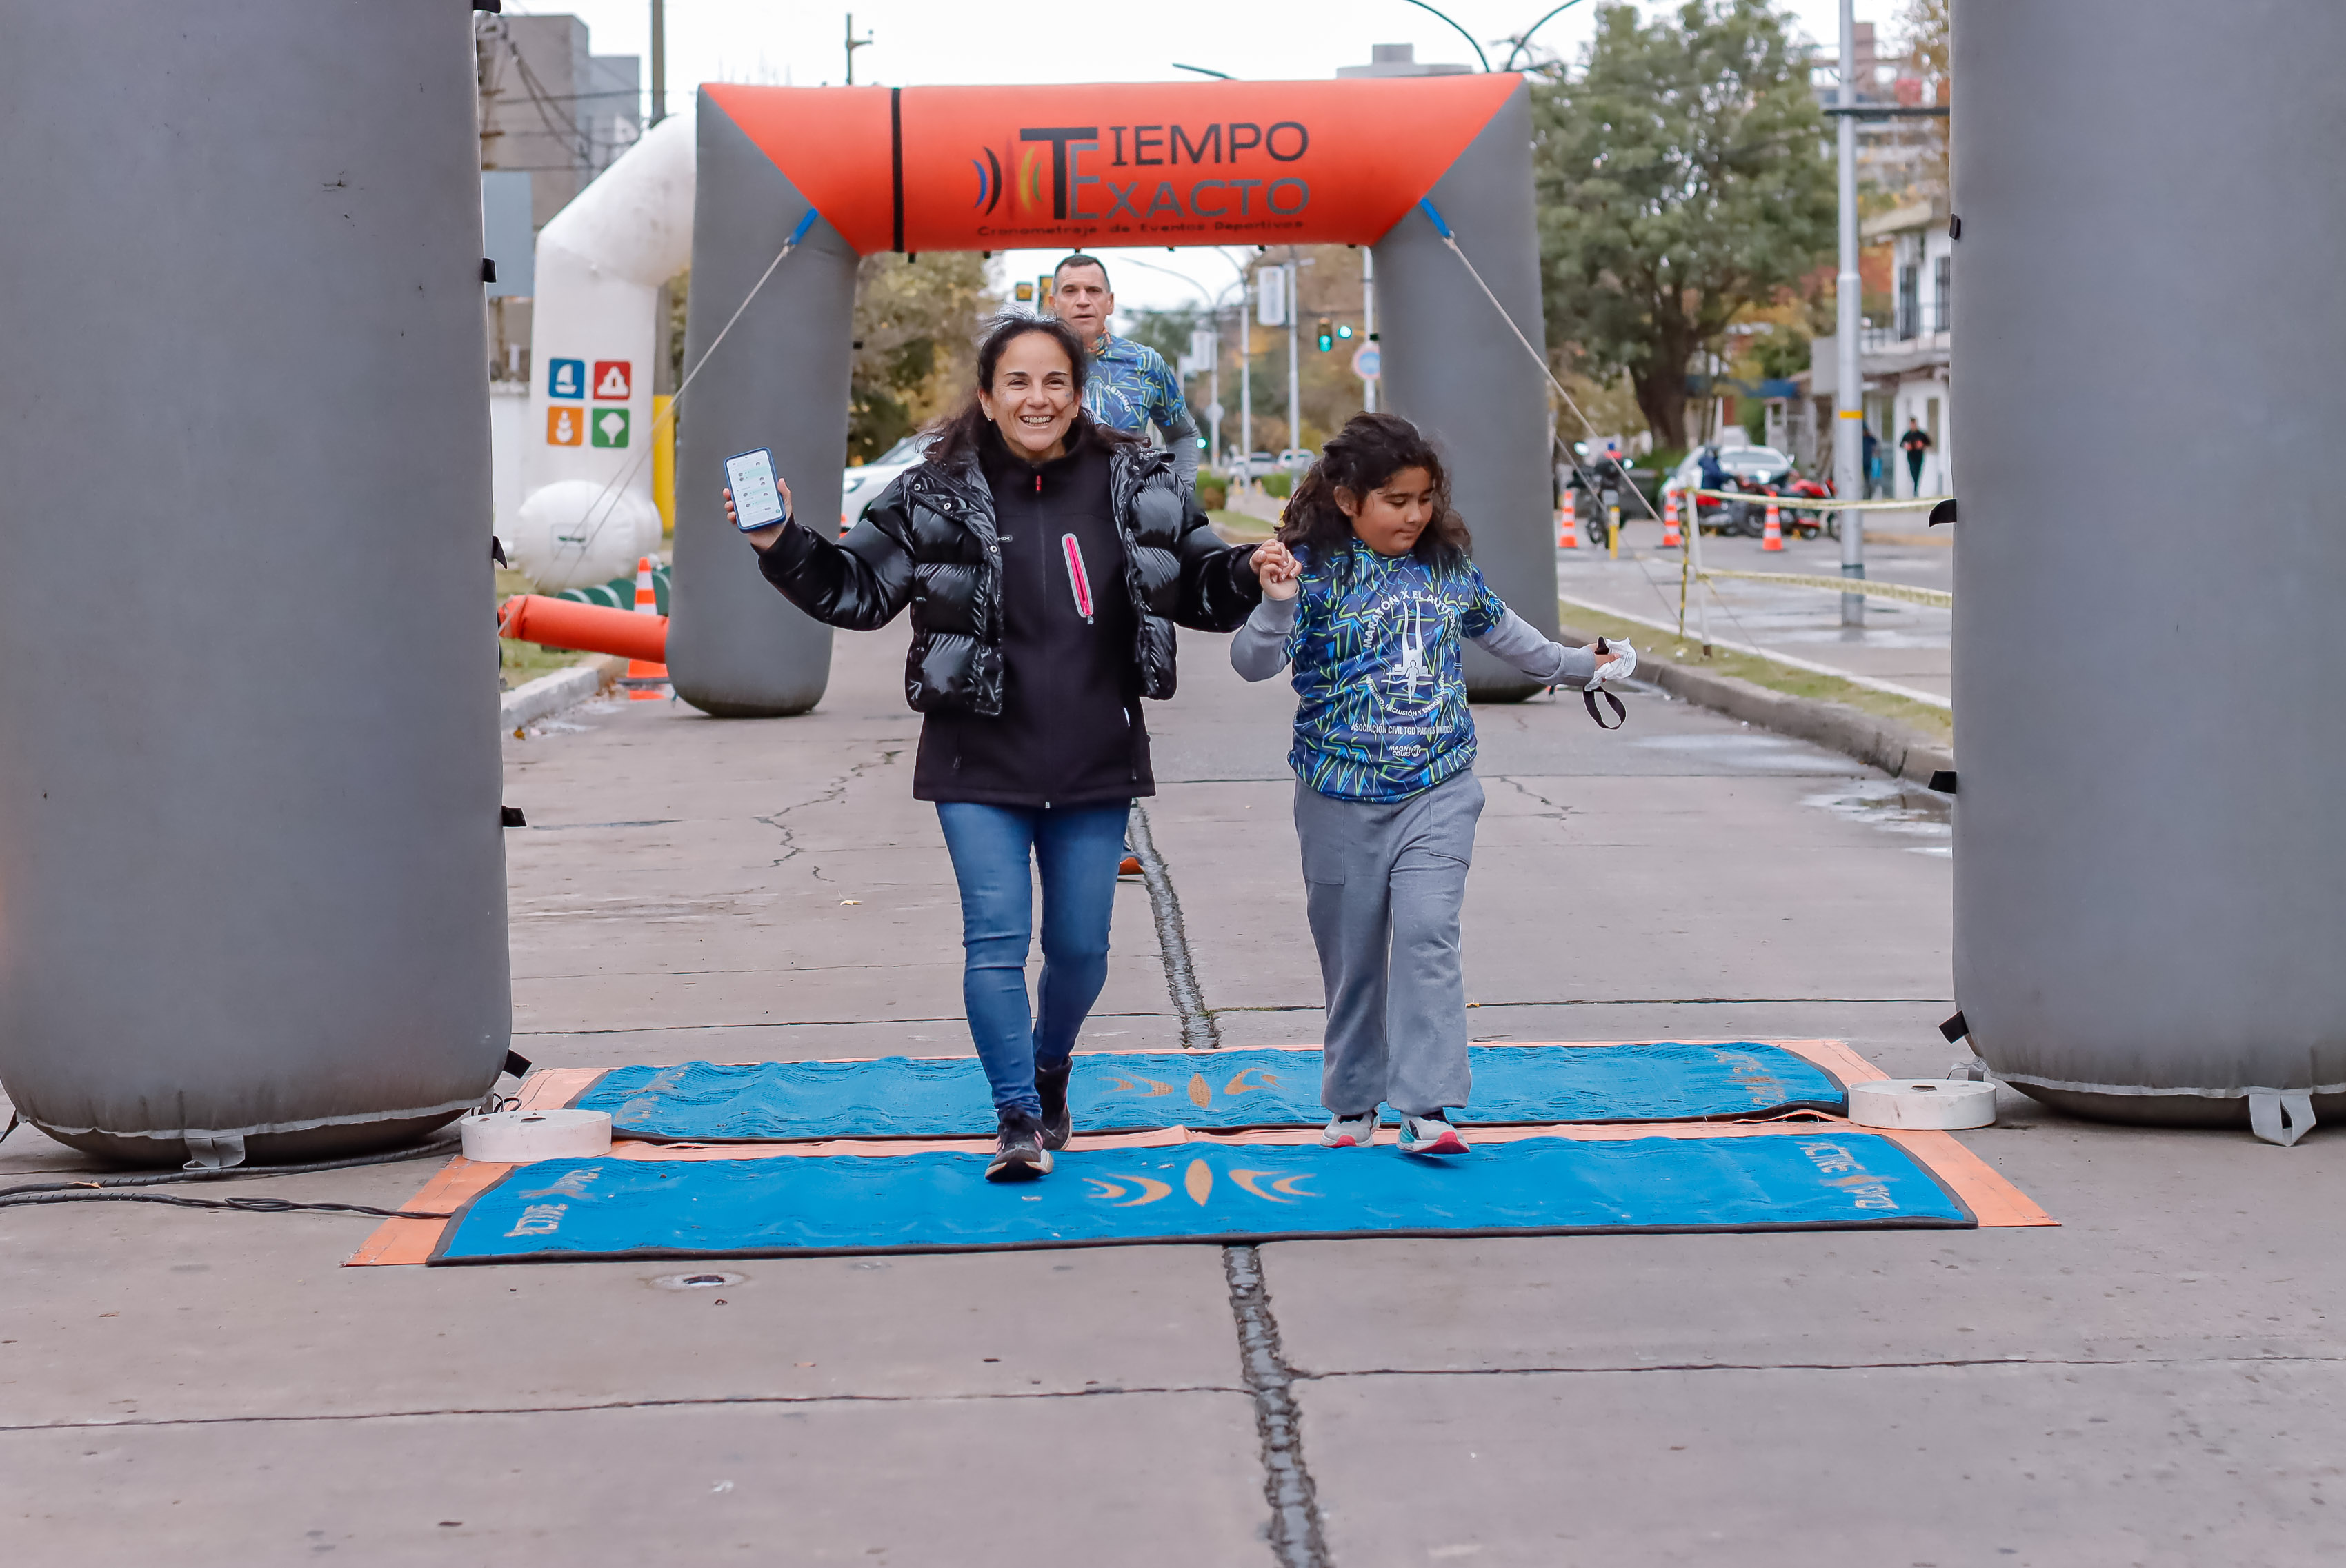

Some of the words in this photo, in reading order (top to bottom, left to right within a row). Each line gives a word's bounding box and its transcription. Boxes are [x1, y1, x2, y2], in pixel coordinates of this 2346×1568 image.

[1020, 121, 1309, 219] TIEMPO
[1070, 143, 1310, 220] EXACTO
[977, 226, 1097, 237] Cronometraje
[1109, 224, 1130, 232] de
[1140, 223, 1205, 232] Eventos
[1215, 221, 1303, 231] Deportivos
[1400, 590, 1410, 600] X
[1412, 590, 1424, 600] EL
[1385, 704, 1417, 717] INCLUSIÓN
[1351, 722, 1387, 735] ASOCIACIÓN
[1388, 726, 1403, 735] CIVIL
[1404, 726, 1416, 735] TGD
[1417, 726, 1435, 735] PADRES
[1436, 725, 1453, 734] UNIDOS
